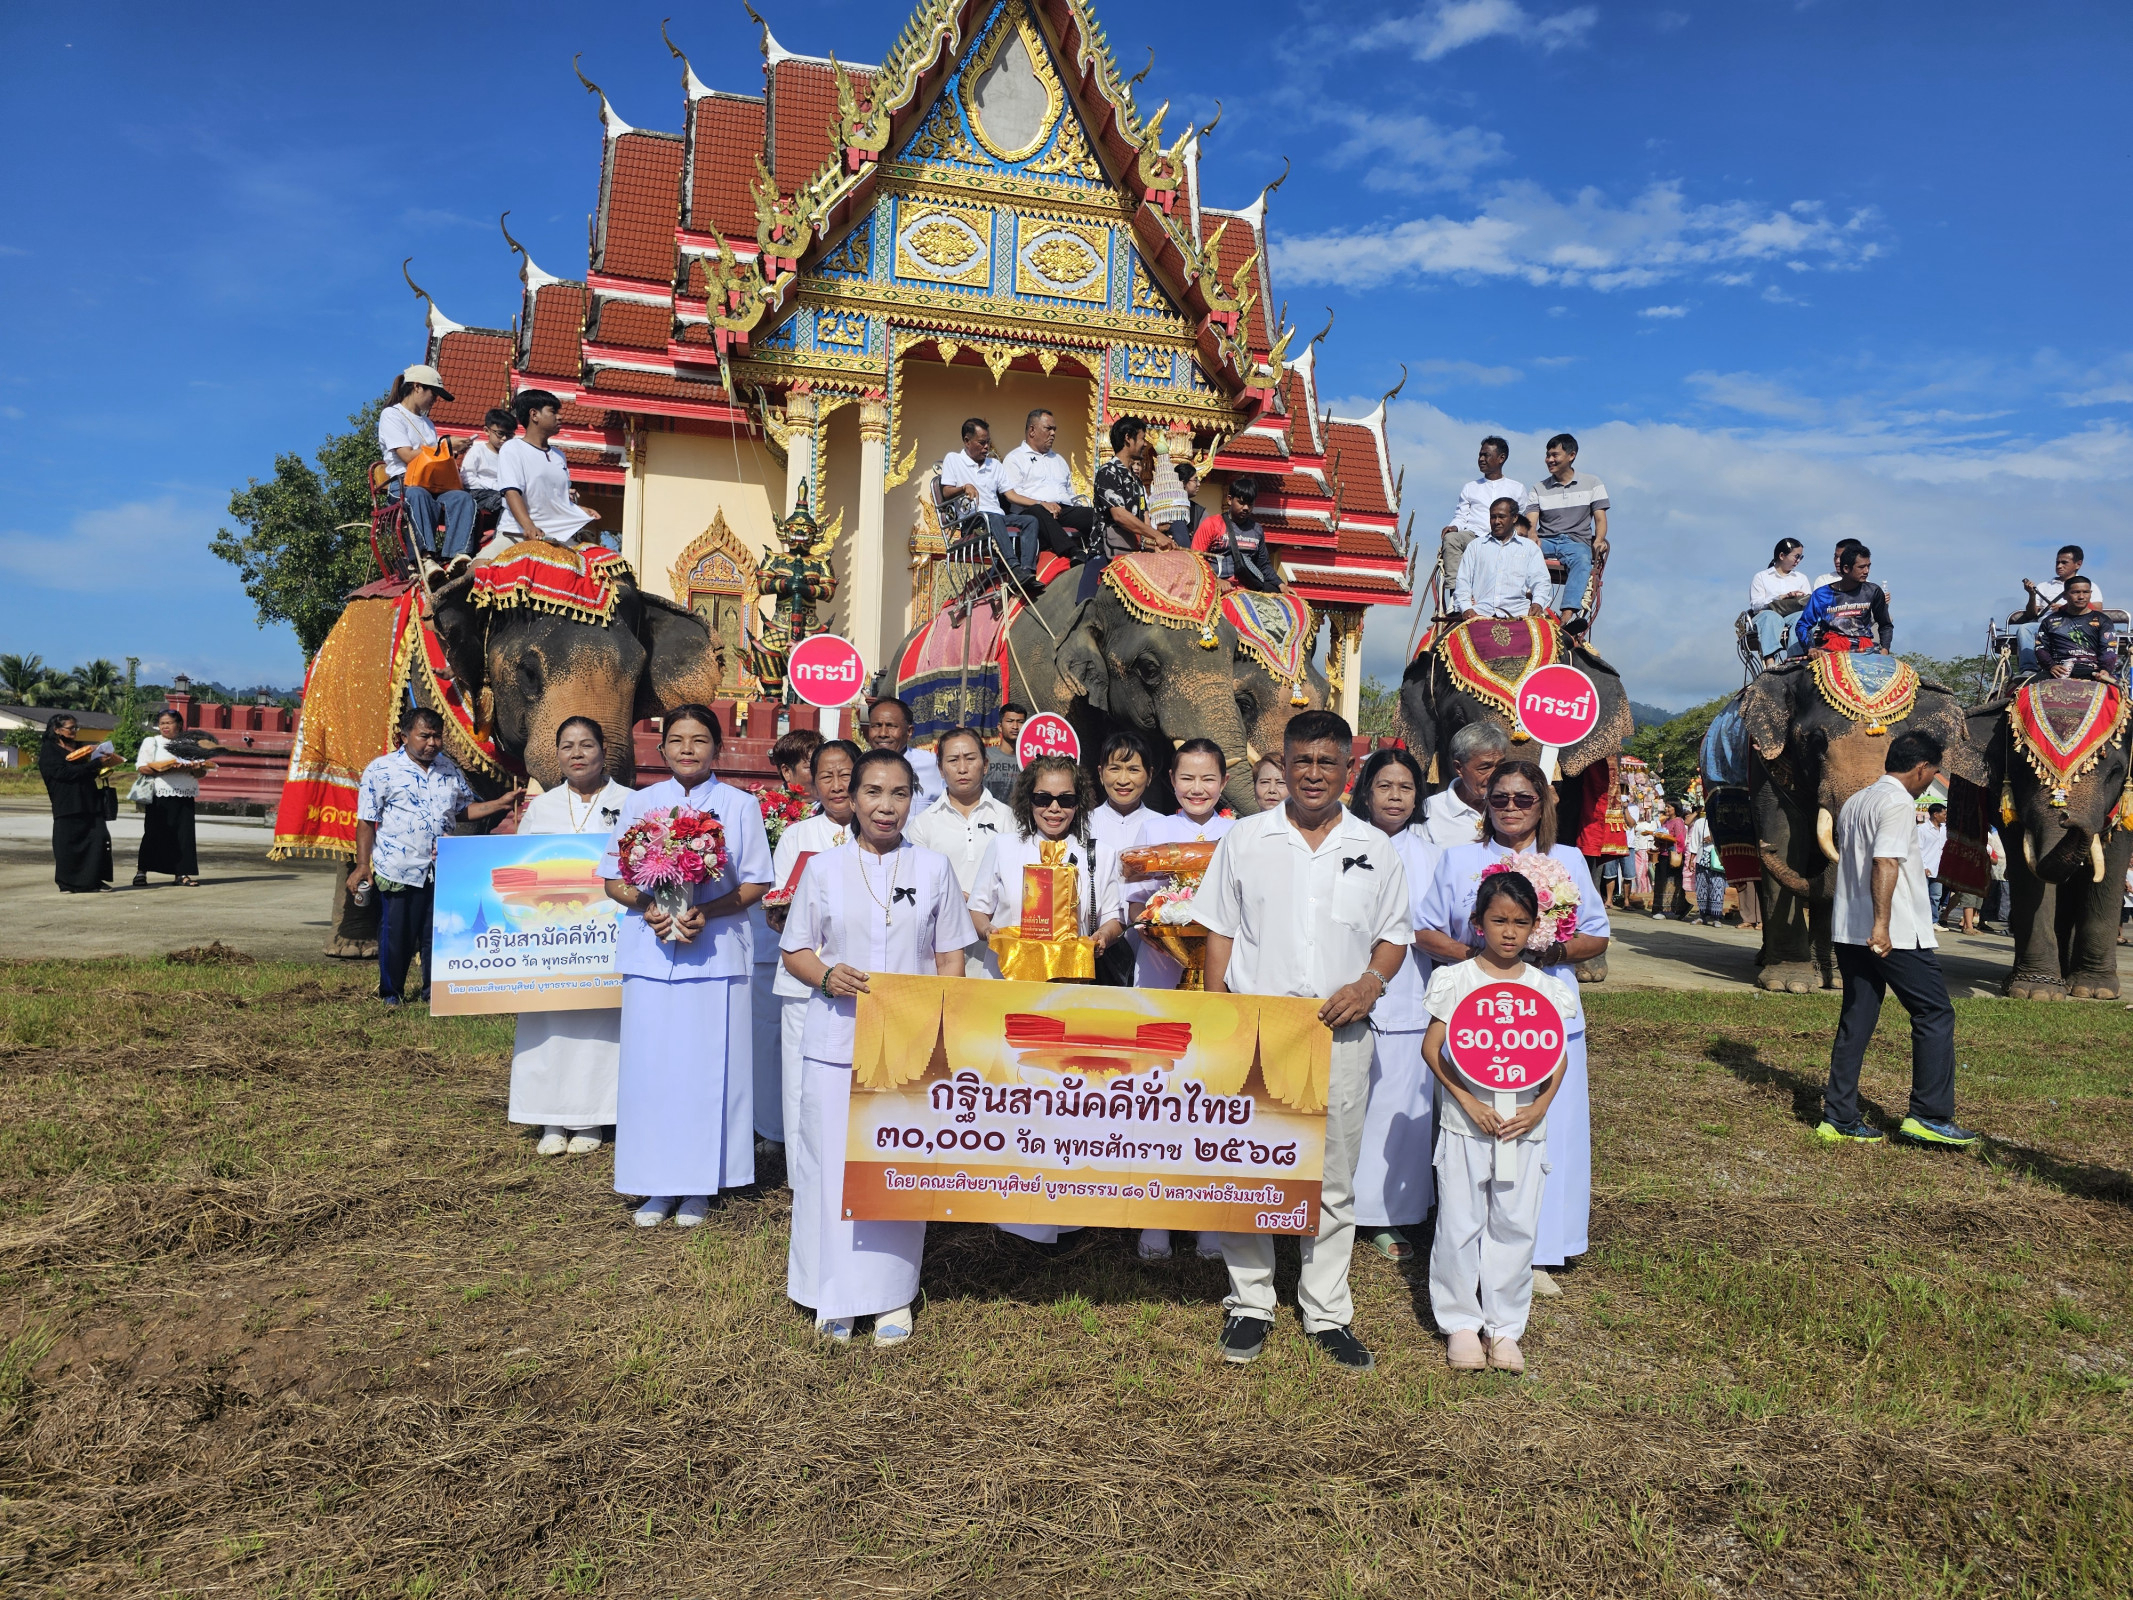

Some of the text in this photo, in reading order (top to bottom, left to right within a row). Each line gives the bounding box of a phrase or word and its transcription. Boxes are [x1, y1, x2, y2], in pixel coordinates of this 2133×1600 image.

[796, 653, 856, 682] กระบี่
[1525, 690, 1592, 721] กระบี่
[1036, 721, 1067, 745] กฐิน
[476, 918, 619, 954] กฐินสามัคคีทั่วไ
[448, 952, 609, 972] ๓๐,๐๐๐ วัด พุทธศักราช
[1475, 991, 1538, 1024] กฐิน
[1456, 1028, 1559, 1052] 30,000
[1486, 1056, 1526, 1082] วัด
[931, 1070, 1251, 1125] กฐินสามัคคีทั่วไทย
[876, 1126, 1297, 1166] ๓๐,๐๐๐ วัด พุทธศักราช ๒๕๖๘
[886, 1170, 1283, 1204] โดย คณะศิษยานุศิษย์ บูชาธรรม ๘๑ ปี หลวงพ่อธัมมชโย
[1256, 1202, 1307, 1228] กระบี่
